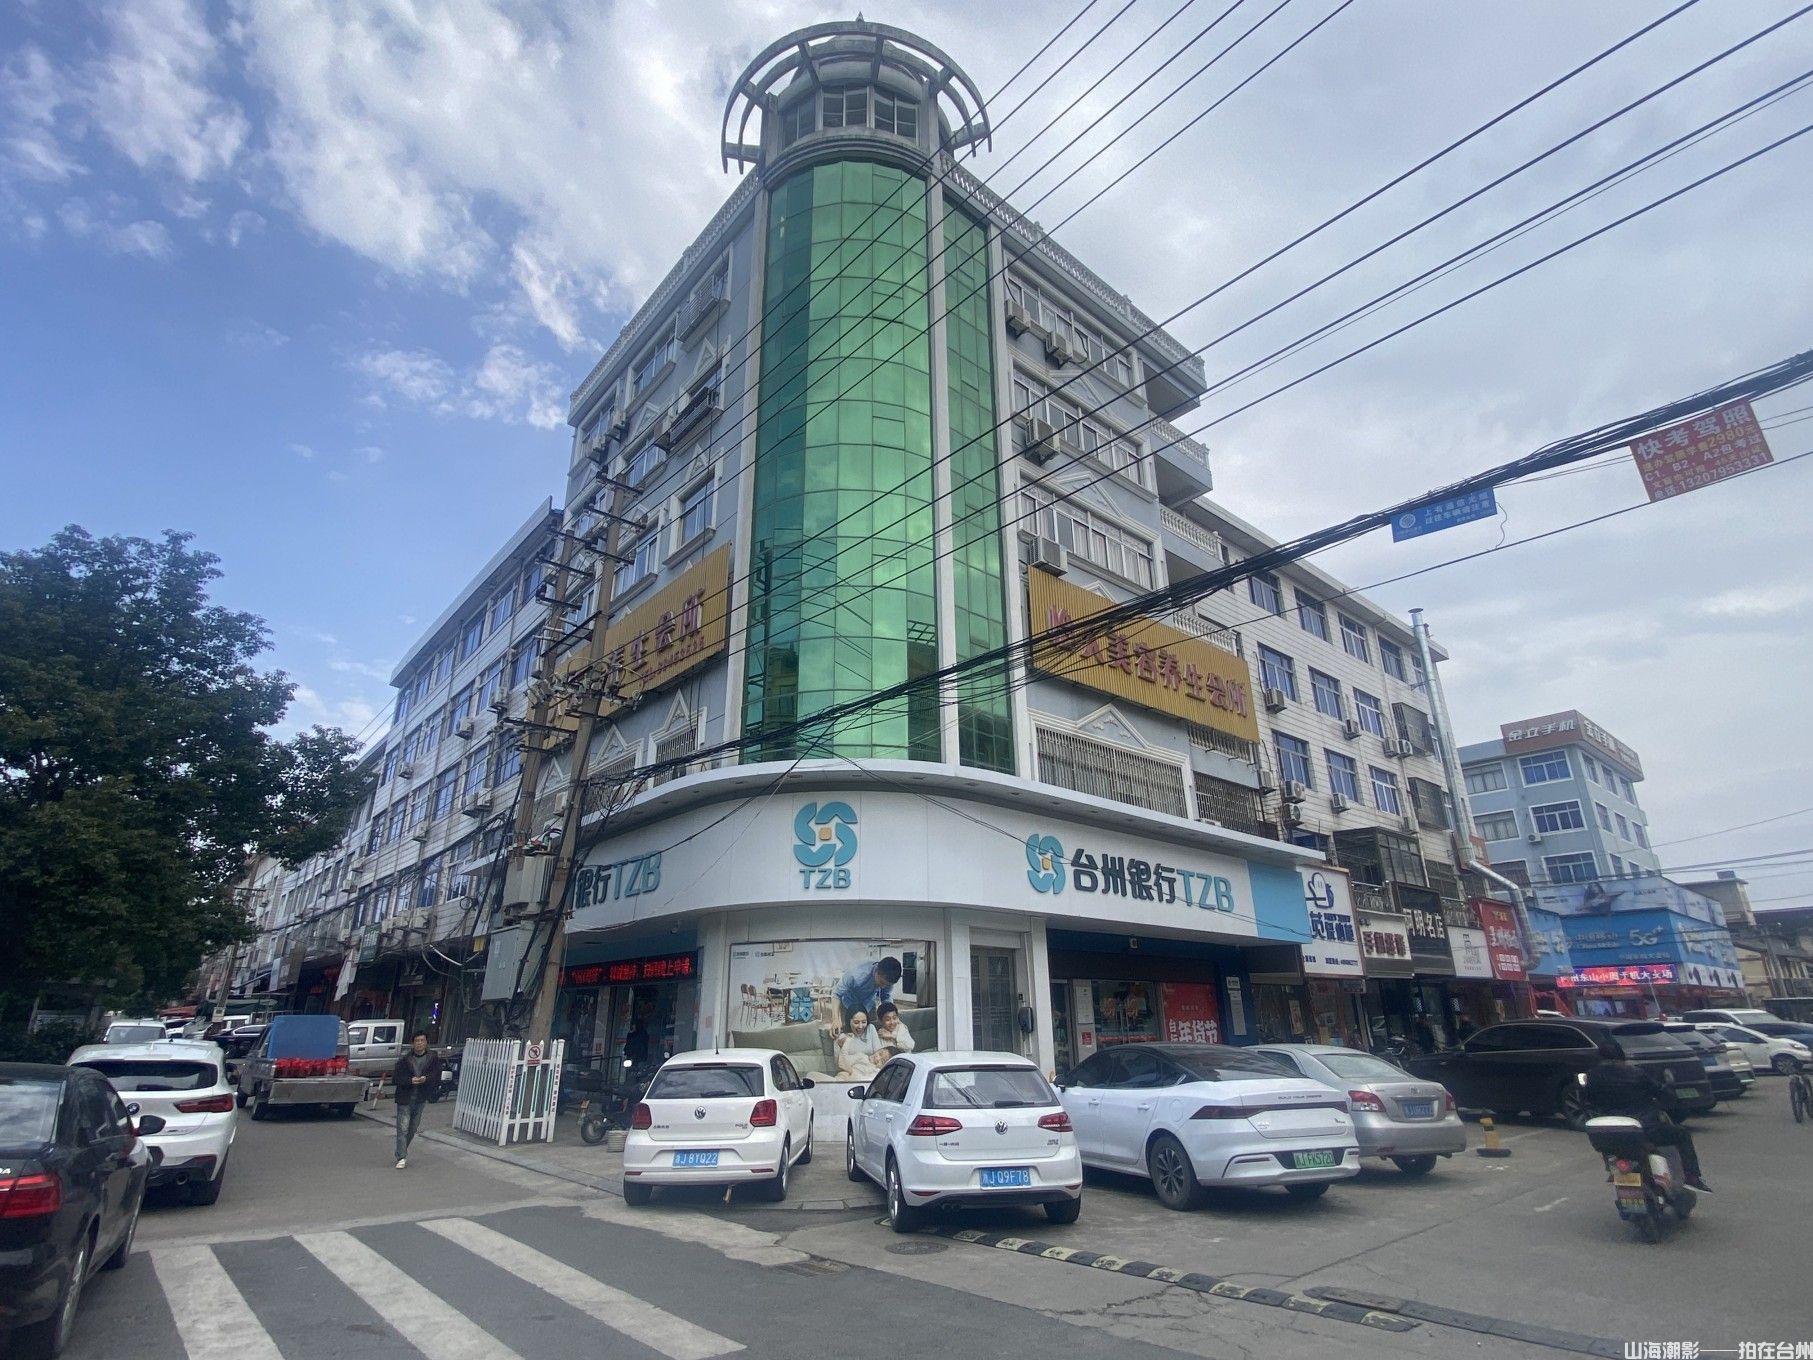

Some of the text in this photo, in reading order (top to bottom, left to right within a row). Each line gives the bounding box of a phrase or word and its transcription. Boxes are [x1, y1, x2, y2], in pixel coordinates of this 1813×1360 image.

[1637, 404, 1753, 461] 快考驾照
[1048, 606, 1248, 718] 美容养生会所
[1508, 719, 1574, 742] 金立手机
[799, 868, 852, 890] TZB
